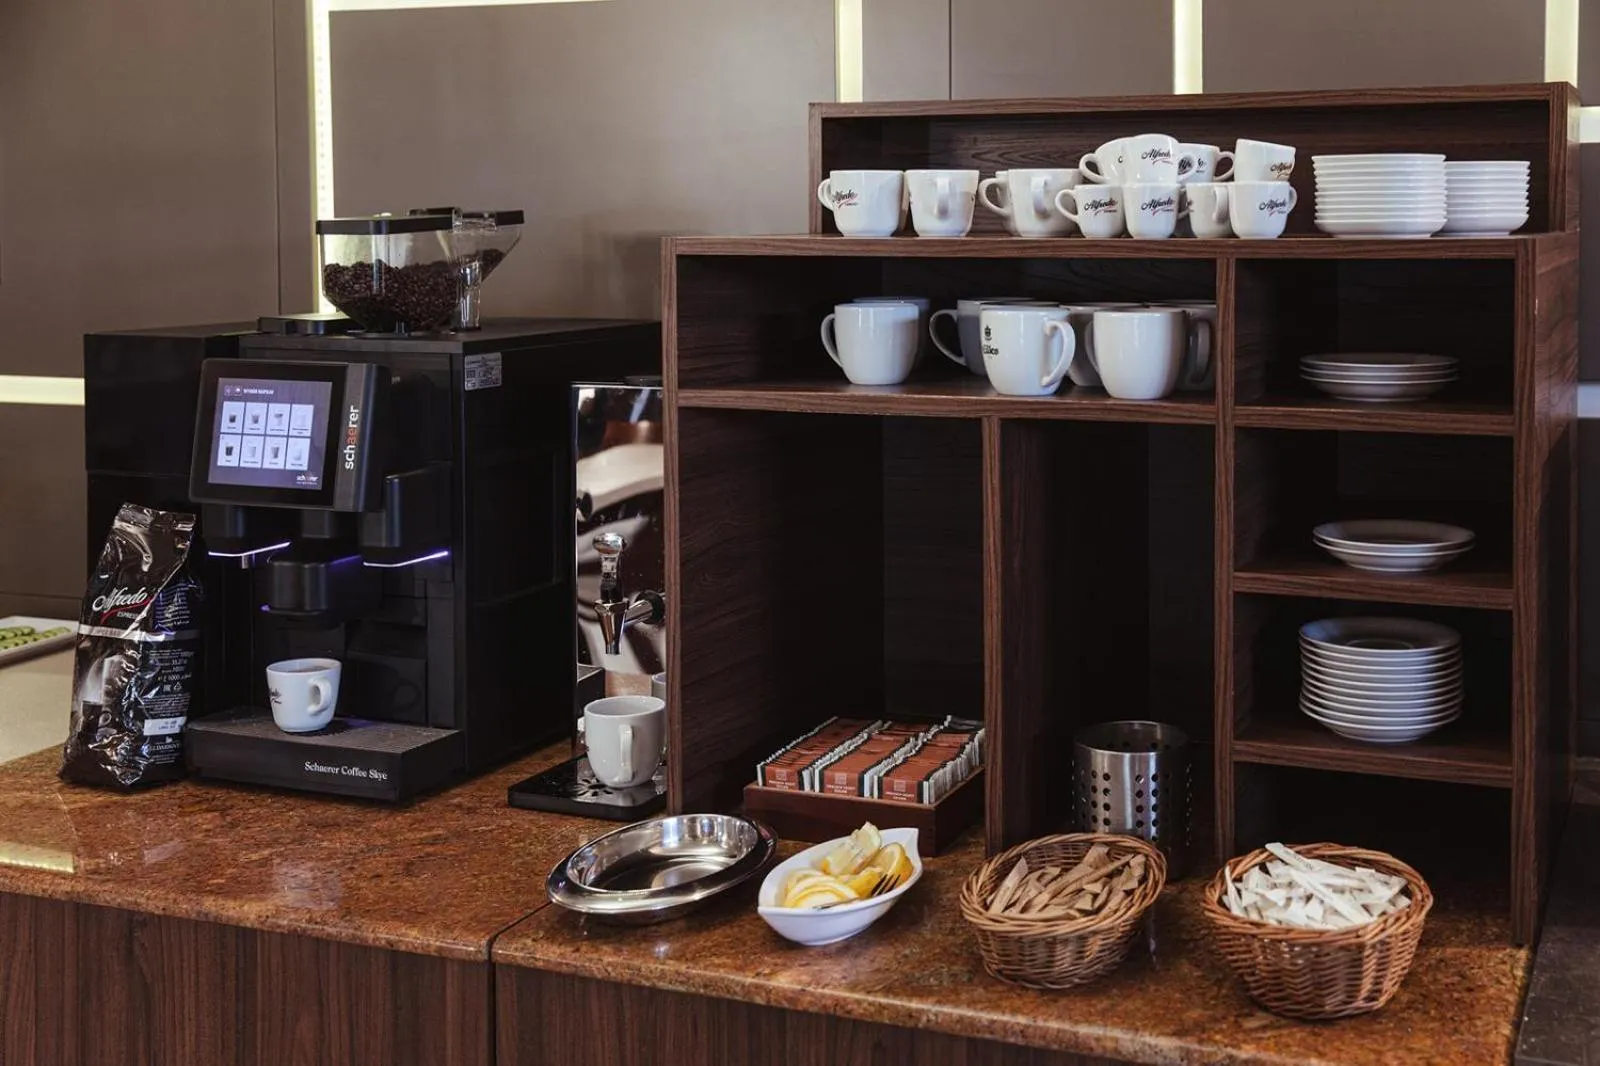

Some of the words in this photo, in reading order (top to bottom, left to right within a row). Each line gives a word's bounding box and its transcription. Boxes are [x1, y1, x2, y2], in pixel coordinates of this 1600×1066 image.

[344, 404, 360, 470] schaerer
[92, 586, 148, 613] Alfredo
[304, 761, 340, 774] Schaerer
[341, 766, 367, 778] Coffee
[368, 769, 388, 781] Skye
